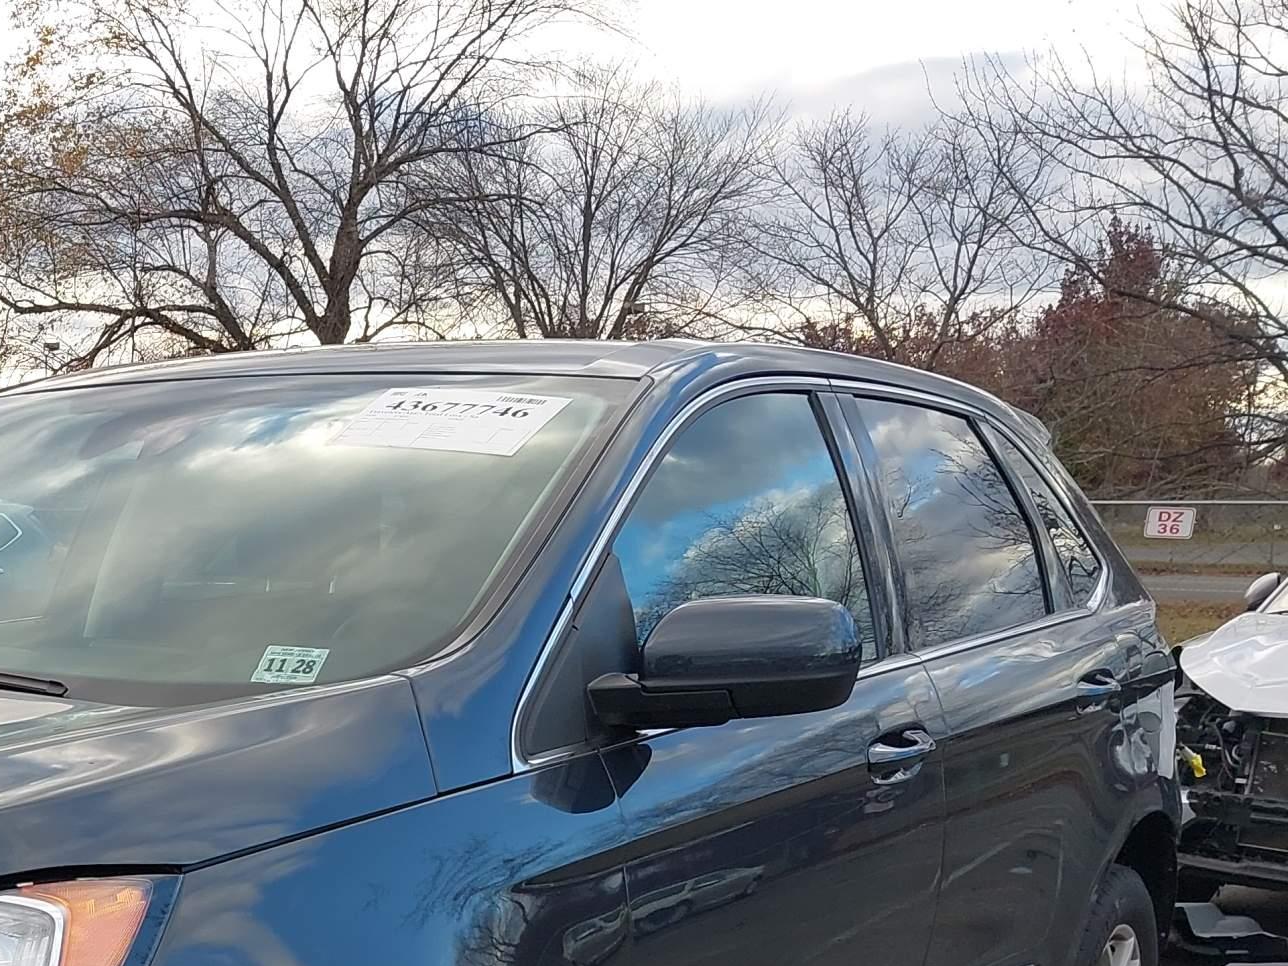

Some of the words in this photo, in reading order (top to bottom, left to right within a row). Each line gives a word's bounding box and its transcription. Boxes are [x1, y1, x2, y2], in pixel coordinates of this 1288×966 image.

[386, 399, 535, 418] 43677746
[1158, 511, 1184, 523] DZ
[1157, 523, 1180, 534] 36
[263, 658, 287, 673] 11
[290, 659, 316, 674] 28
